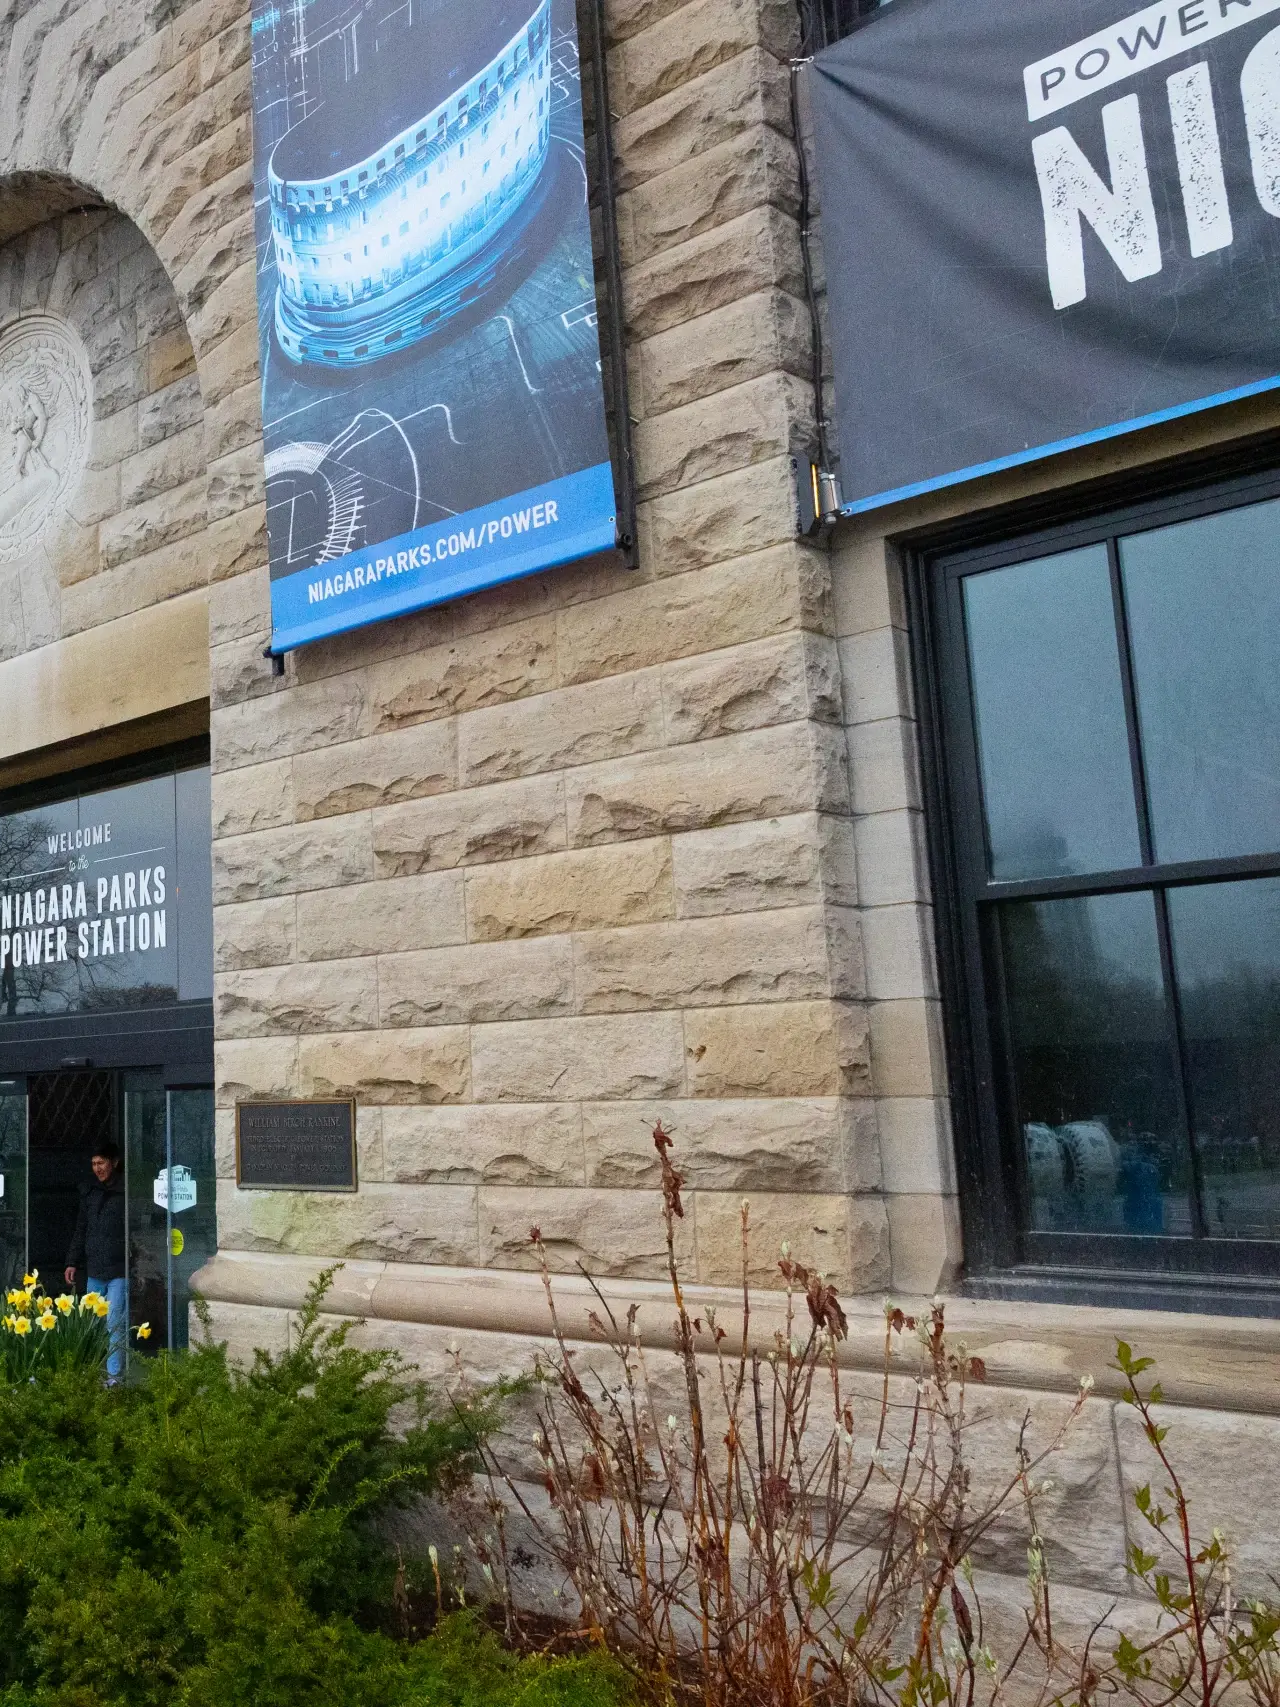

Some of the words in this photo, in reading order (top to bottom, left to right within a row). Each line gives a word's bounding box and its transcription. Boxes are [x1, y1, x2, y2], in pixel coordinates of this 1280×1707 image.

[307, 500, 559, 604] NIAGARAPARKS.COM/POWER
[48, 823, 111, 854] WELCOME
[69, 860, 76, 872] to
[78, 855, 89, 870] the
[1, 881, 87, 930] NIAGARA
[97, 865, 166, 913] PARKS
[0, 926, 68, 969] POWER
[78, 909, 166, 959] STATION
